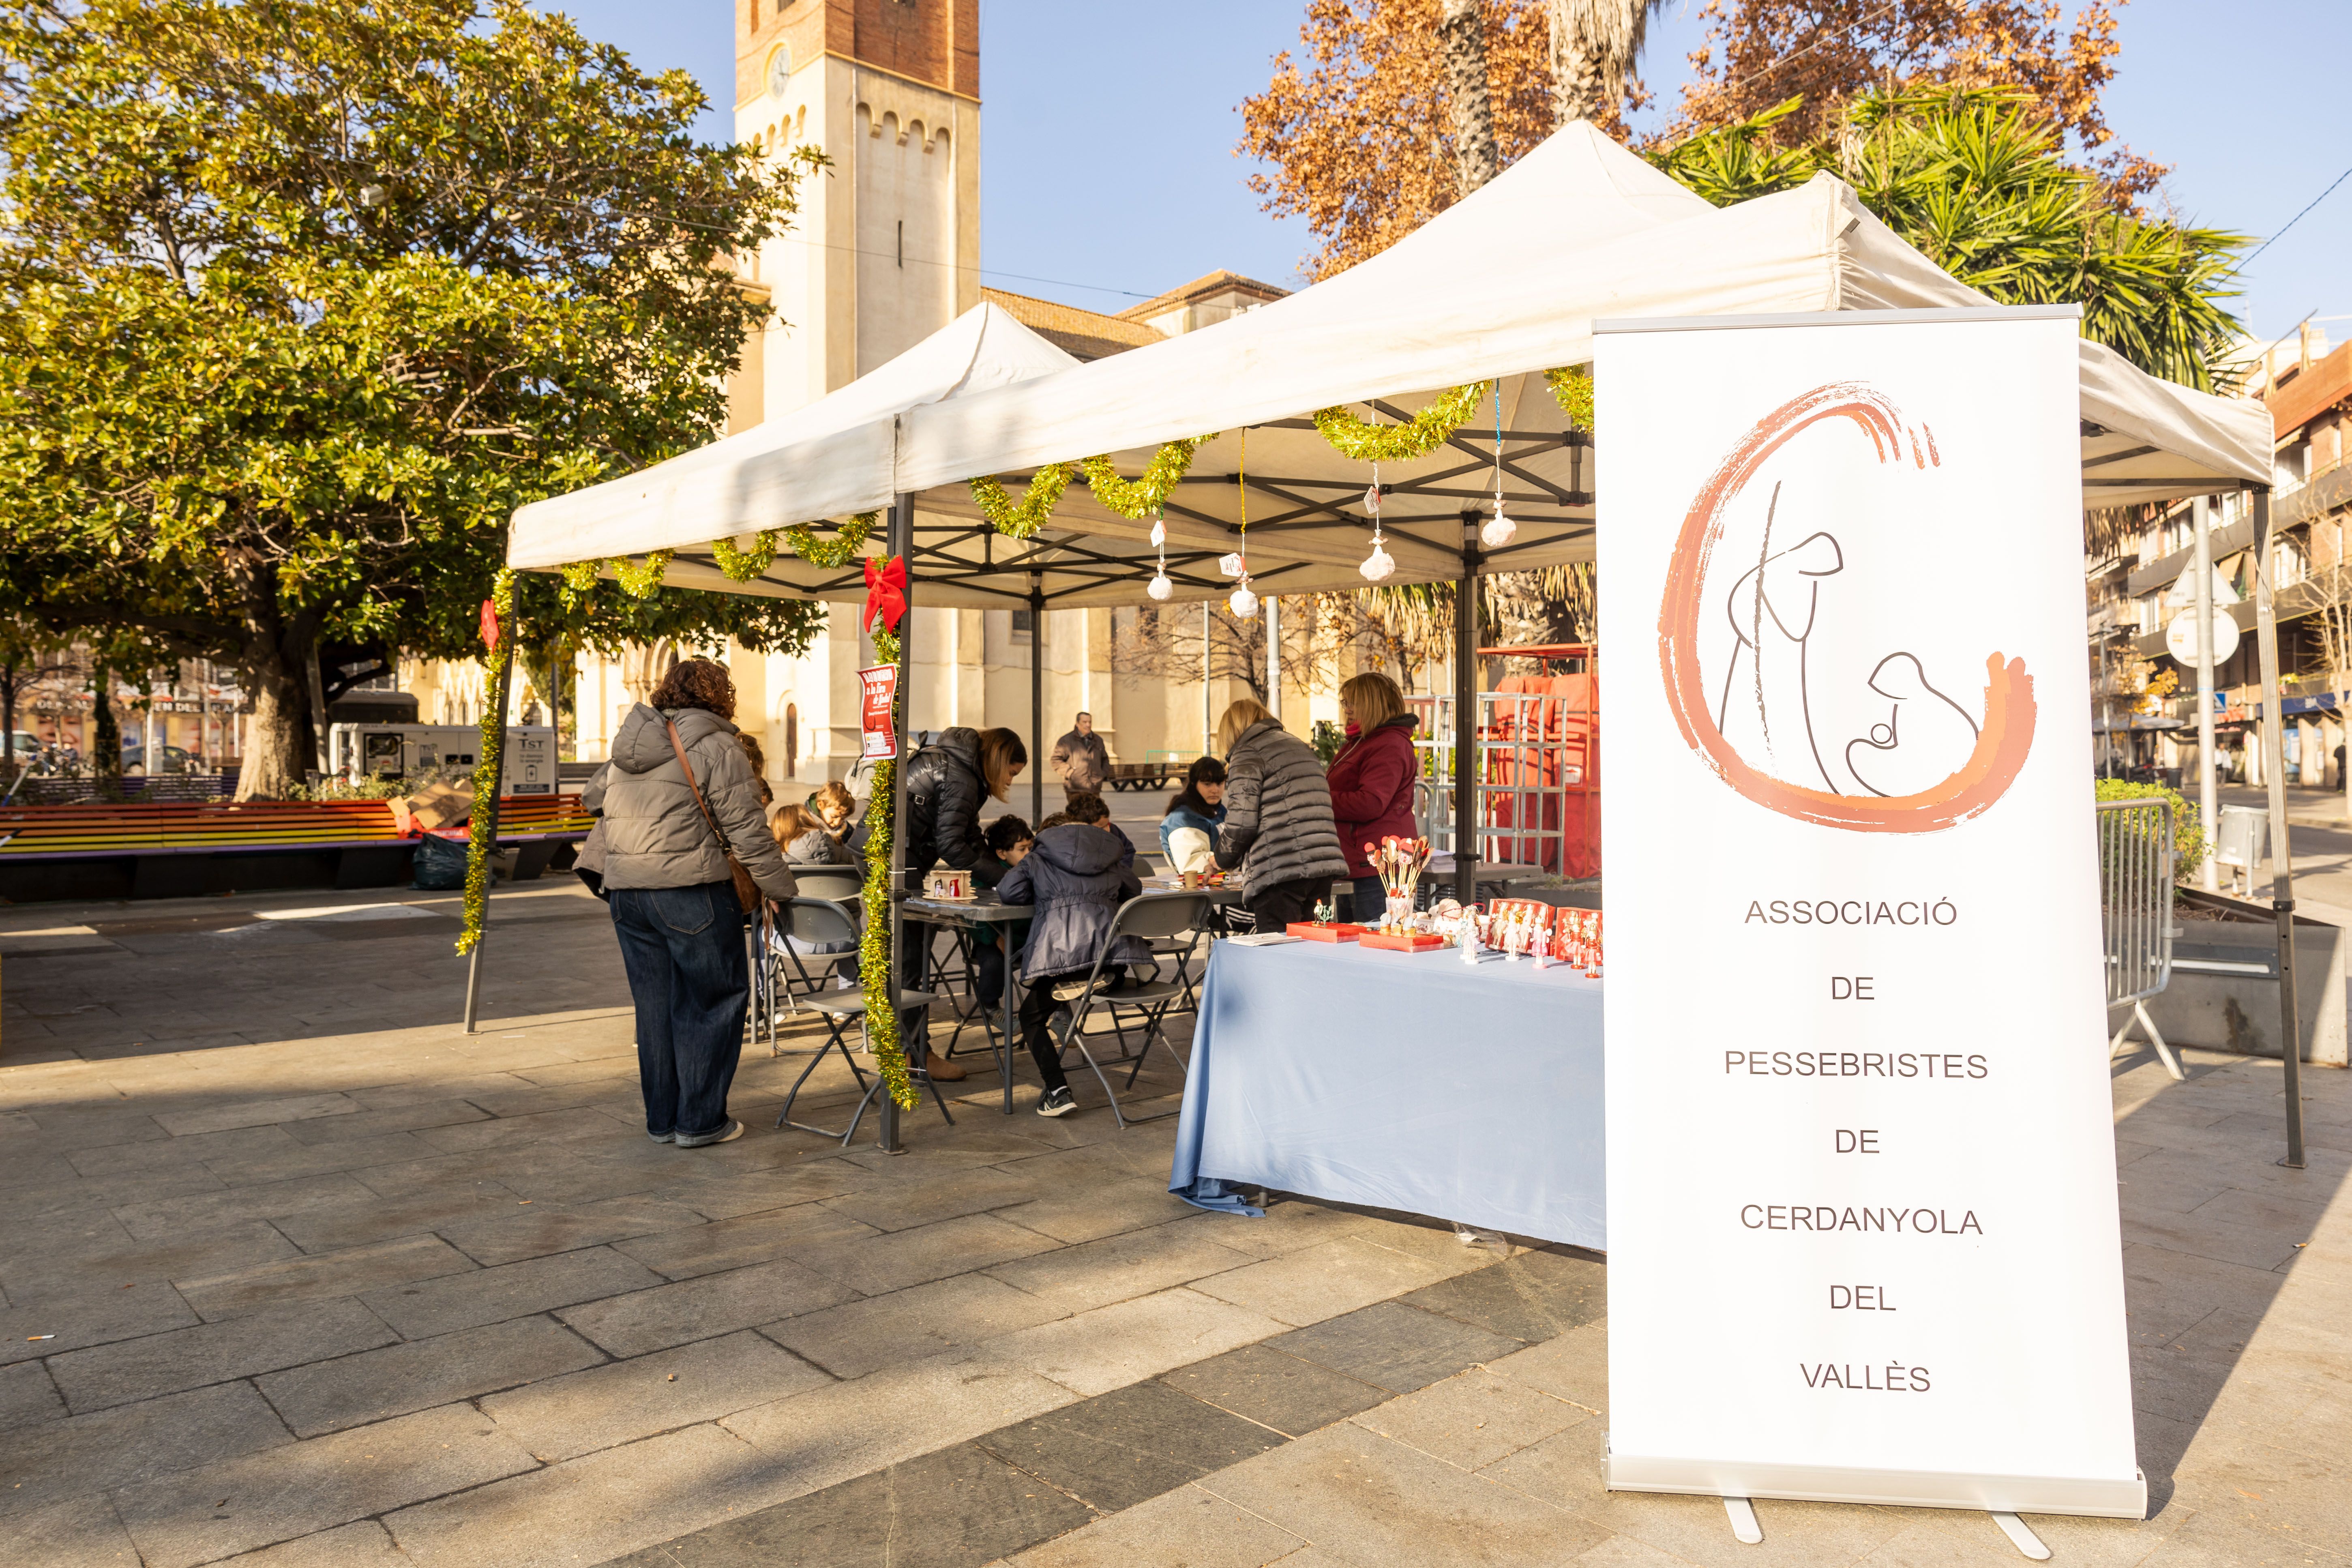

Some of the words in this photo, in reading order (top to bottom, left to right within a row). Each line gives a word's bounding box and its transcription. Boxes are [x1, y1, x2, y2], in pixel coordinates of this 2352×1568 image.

[518, 738, 544, 749] TST
[1745, 897, 1957, 925] ASSOCIACIÓ
[1831, 976, 1874, 1000] DE
[1726, 1051, 1988, 1079] PESSEBRISTES
[1836, 1129, 1880, 1154] DE
[1741, 1204, 1983, 1235] CERDANYOLA
[1830, 1285, 1896, 1311] DEL
[1799, 1360, 1931, 1392] VALLÈS
